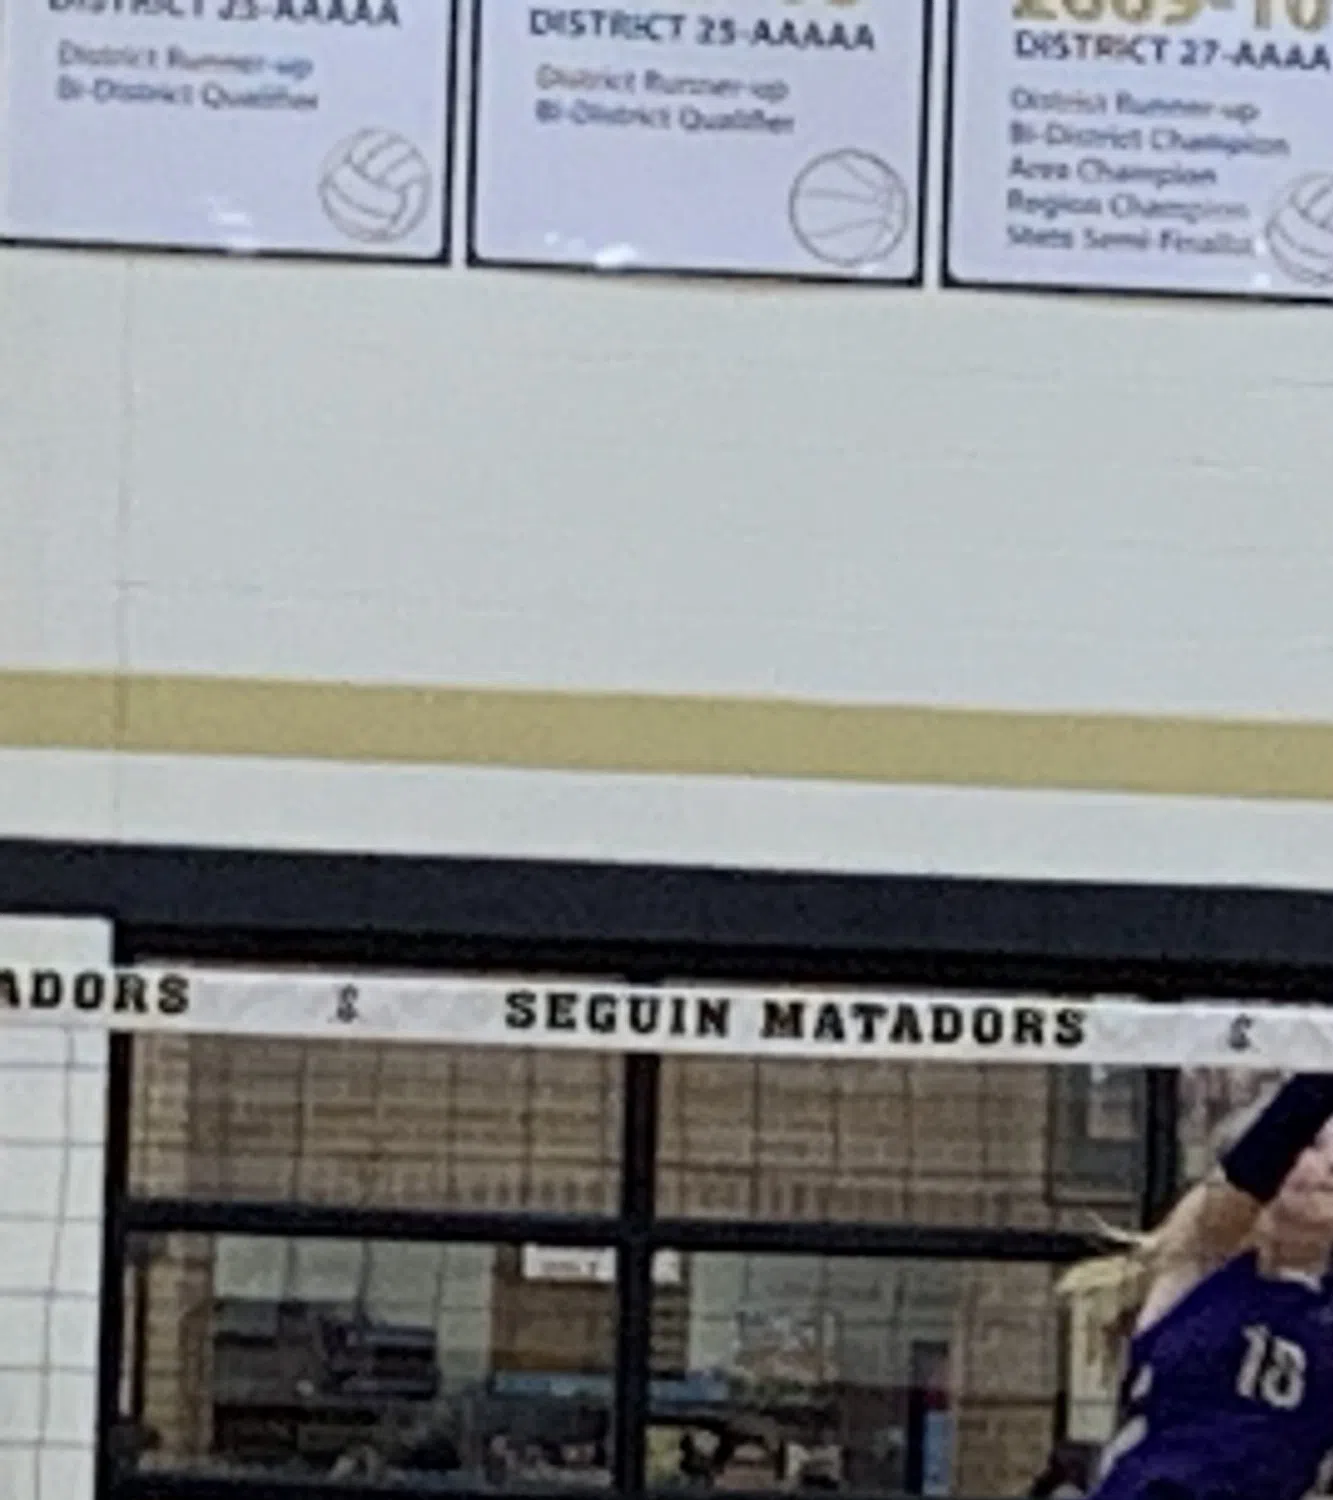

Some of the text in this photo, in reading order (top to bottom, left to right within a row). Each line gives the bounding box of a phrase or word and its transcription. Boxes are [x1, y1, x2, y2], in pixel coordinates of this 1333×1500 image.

[530, 9, 875, 50] DISTRICT 25-AAAAA
[1015, 29, 1331, 72] DISTRICT 27-AAAA
[1151, 127, 1290, 159] Champion
[1077, 157, 1217, 189] Champion
[504, 990, 1087, 1048] SEGUIN MATADORS
